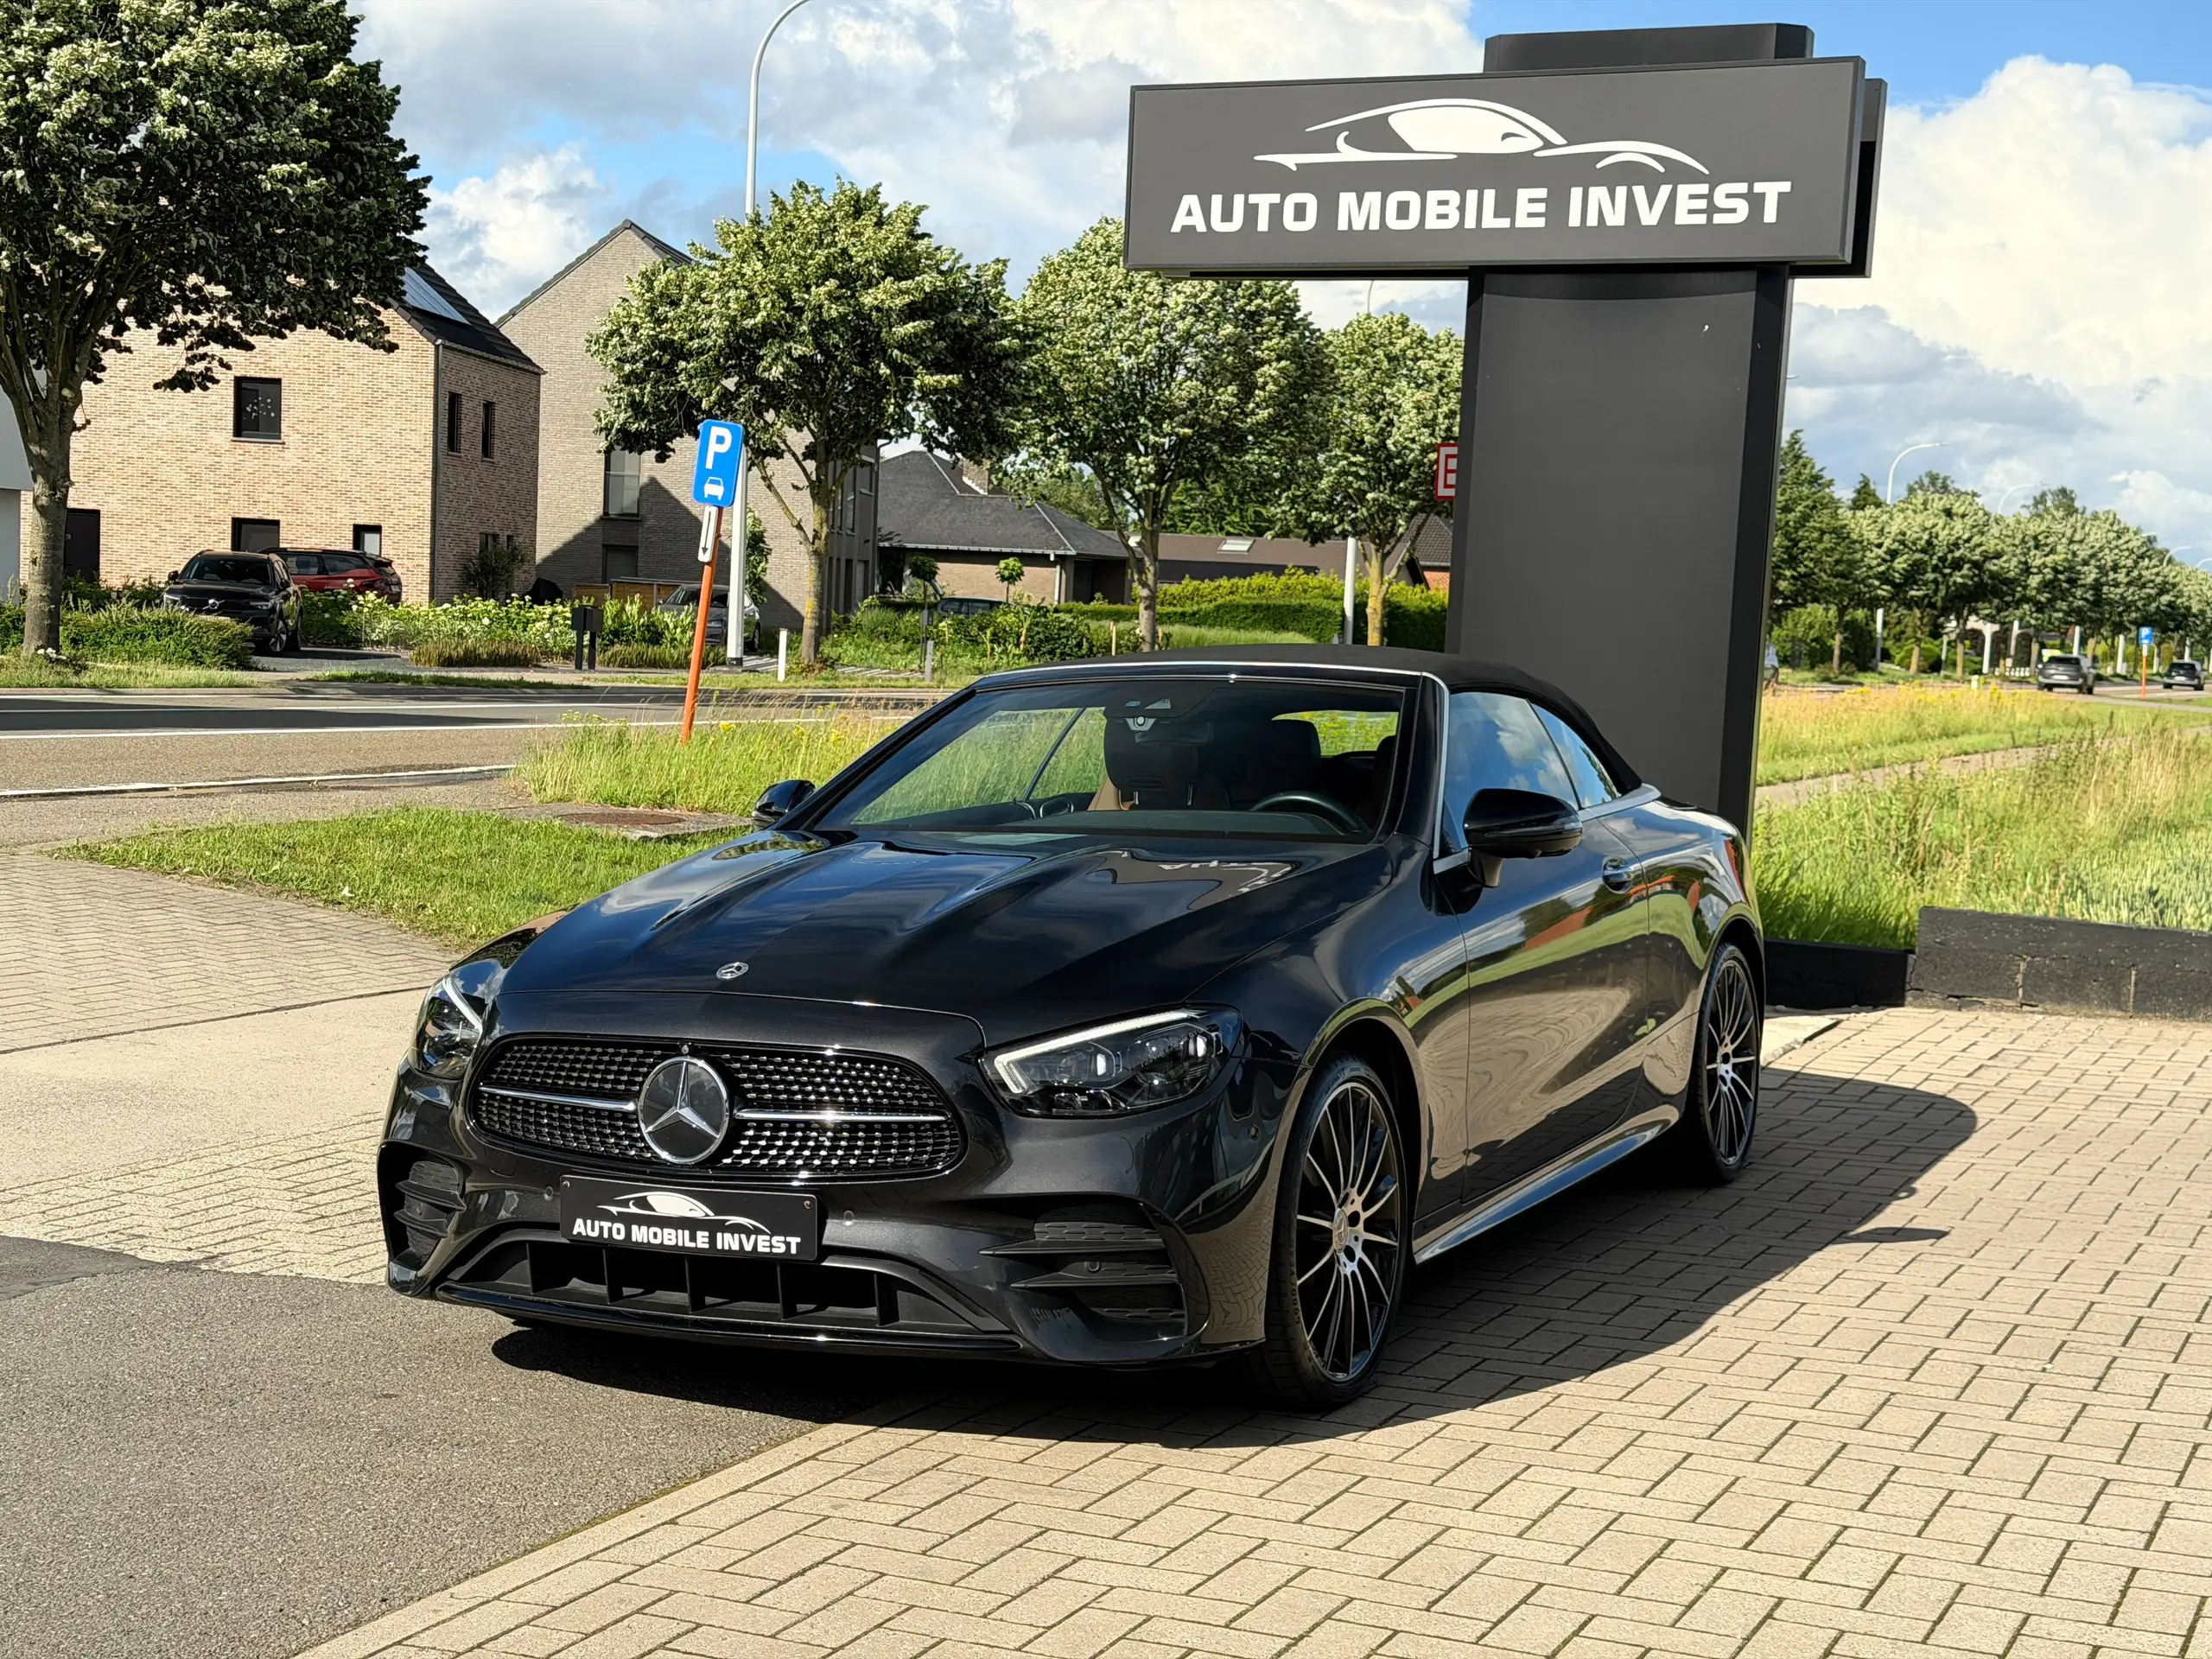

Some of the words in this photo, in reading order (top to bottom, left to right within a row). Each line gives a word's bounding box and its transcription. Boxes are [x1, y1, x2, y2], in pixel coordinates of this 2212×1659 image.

[1170, 191, 1318, 233] AUTO
[1337, 188, 1549, 232] MOBILE
[1567, 181, 1792, 227] INVEST
[705, 426, 732, 469] P
[572, 1217, 626, 1241] AUTO
[631, 1224, 709, 1249] MOBILE
[716, 1231, 802, 1255] INVEST
